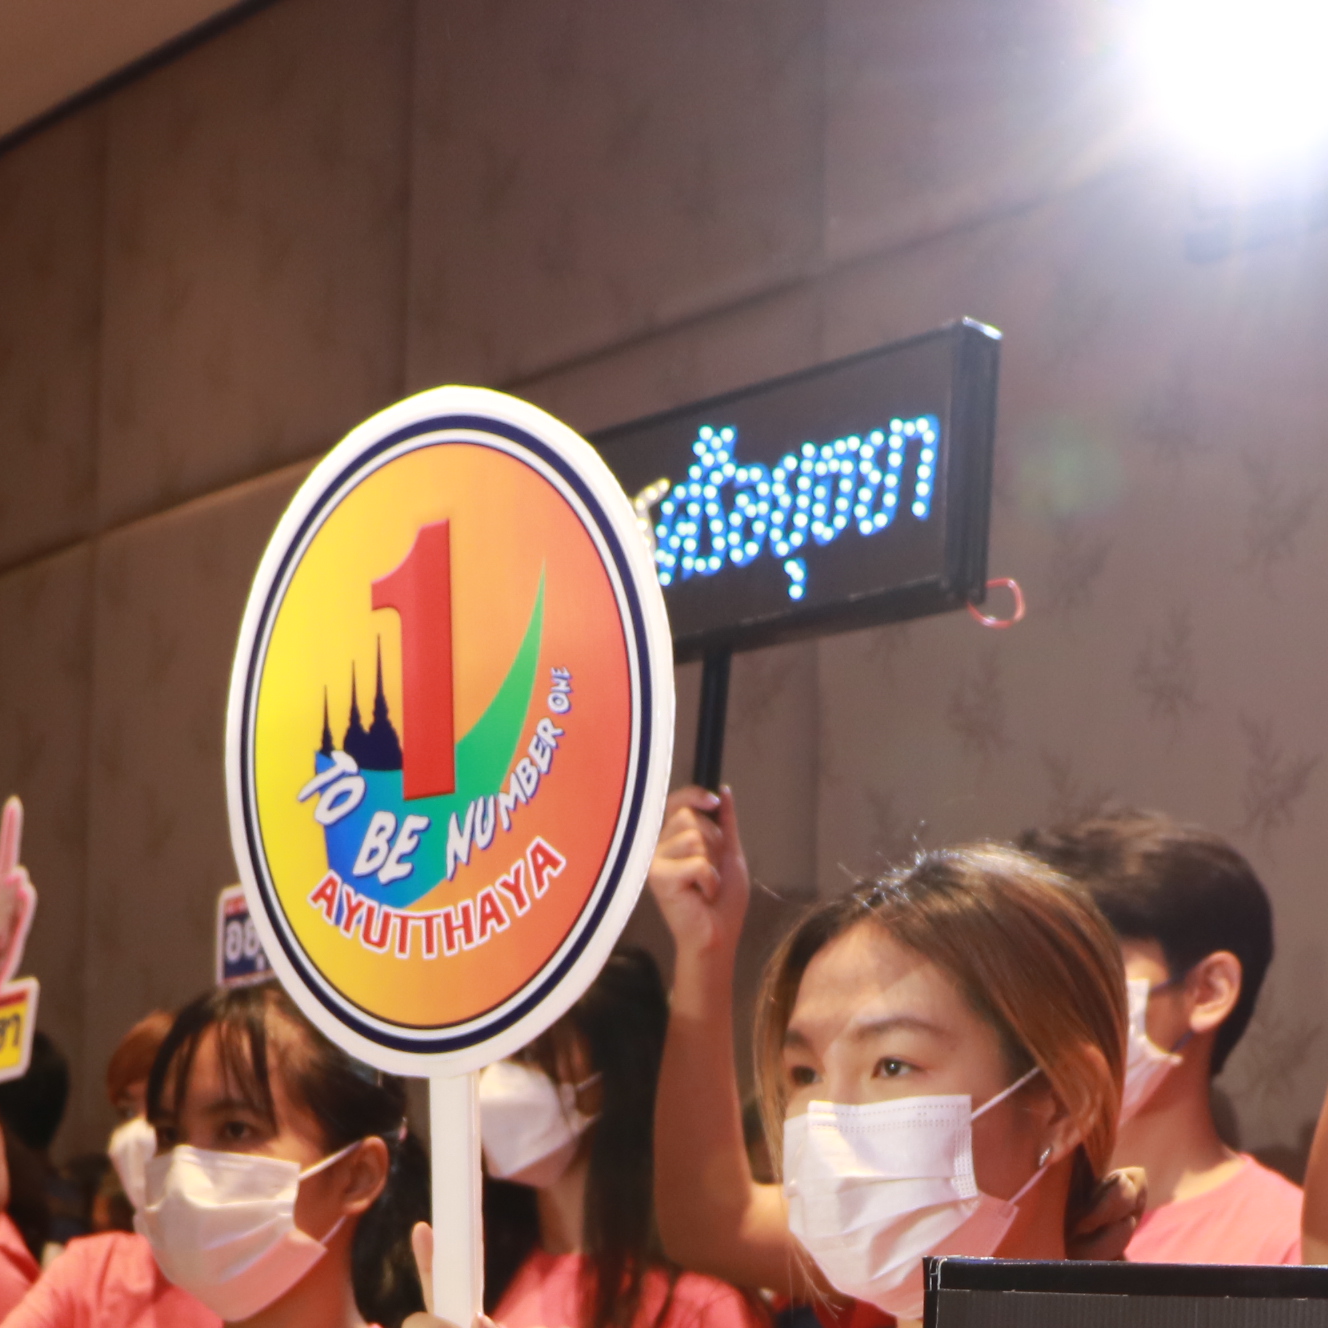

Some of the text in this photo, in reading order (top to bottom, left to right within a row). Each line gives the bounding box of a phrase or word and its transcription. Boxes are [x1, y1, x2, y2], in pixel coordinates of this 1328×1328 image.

[371, 518, 456, 801] 1
[297, 666, 573, 885] TO BE NUMBER ONE
[307, 836, 568, 959] AYUTTHAYA
